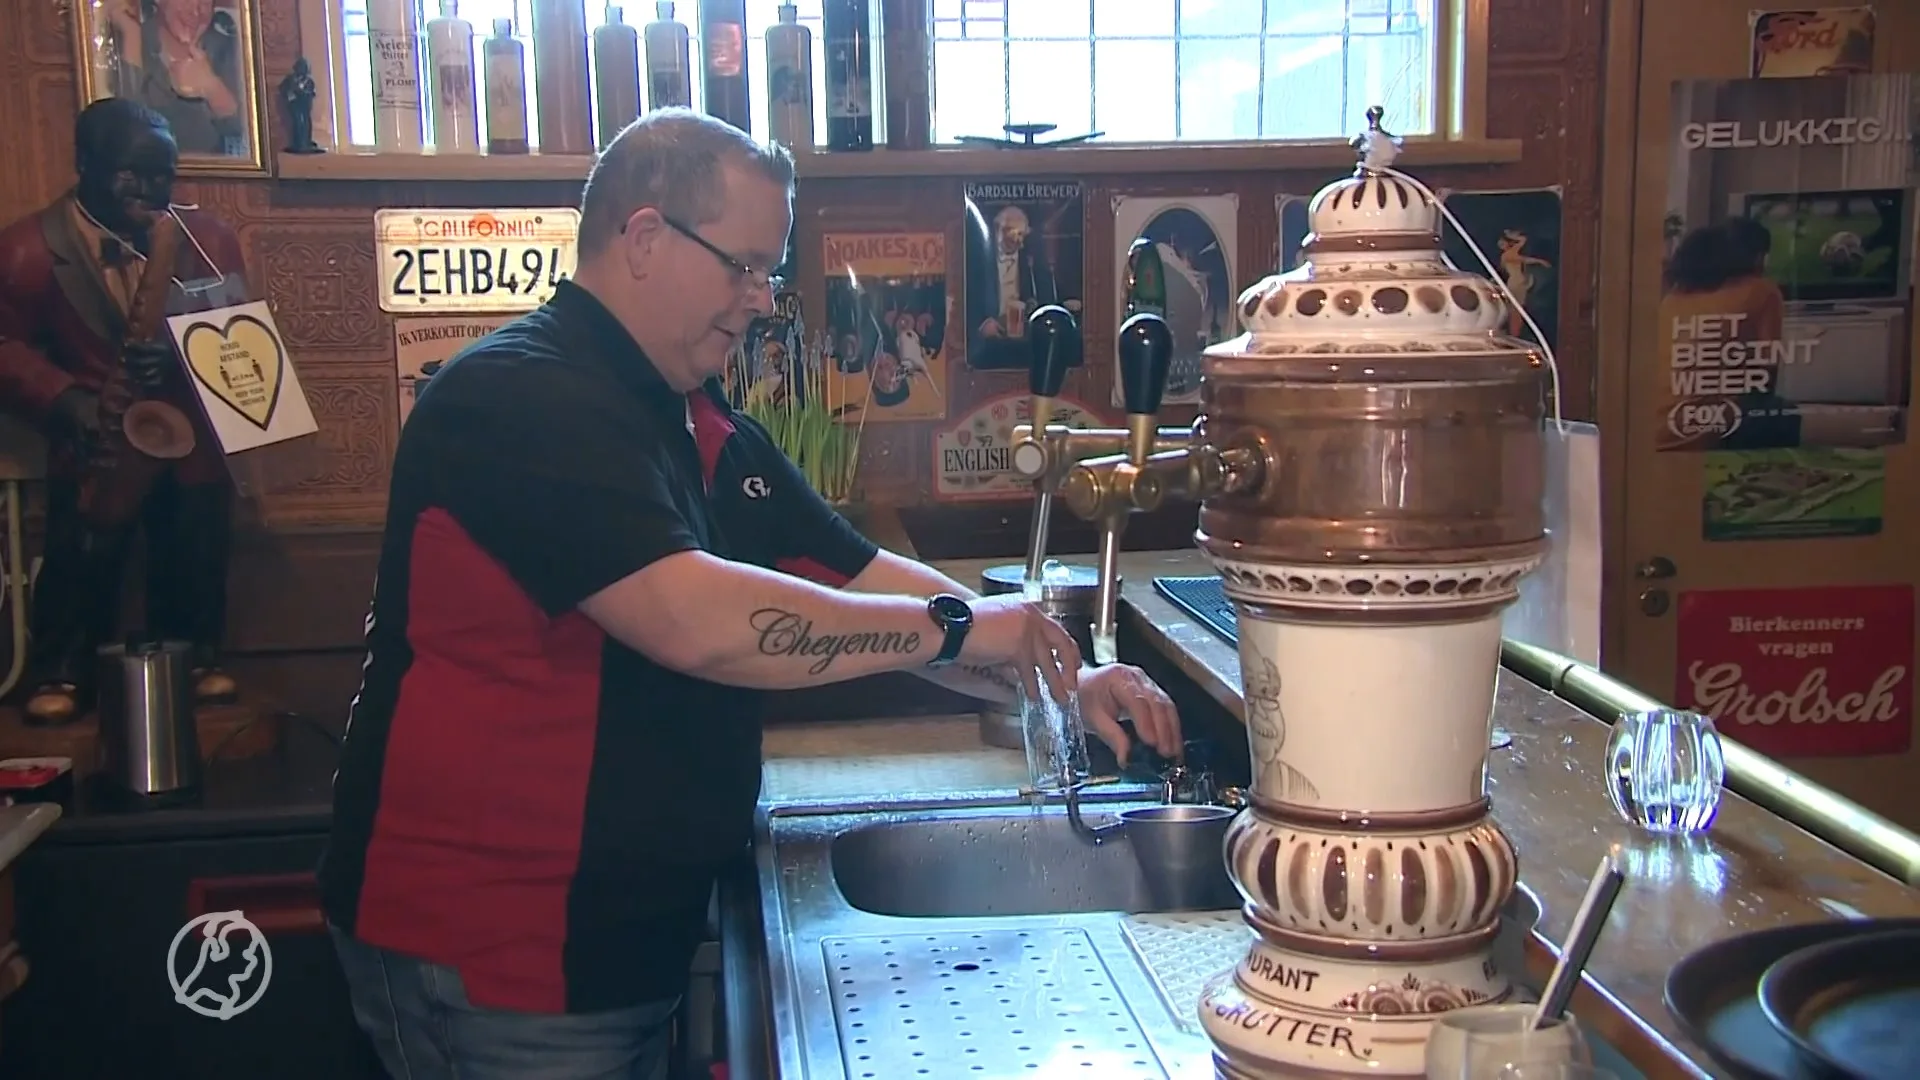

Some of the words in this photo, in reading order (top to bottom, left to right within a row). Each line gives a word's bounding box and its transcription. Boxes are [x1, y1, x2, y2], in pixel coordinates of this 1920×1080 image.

[967, 182, 1026, 198] BARDSLEY
[1027, 183, 1081, 198] BREWERY
[423, 218, 535, 237] CALIFORNIA
[398, 331, 412, 346] IK
[410, 324, 466, 342] VERKOCHT
[467, 325, 481, 338] OP
[1671, 313, 1748, 339] HET
[1671, 340, 1820, 368] BEGINT
[1671, 369, 1770, 396] WEER
[1682, 404, 1728, 425] FOX
[944, 447, 1010, 472] ENGLISH
[1728, 616, 1865, 633] Bierkenners
[749, 608, 921, 676] Cheyenne
[1758, 641, 1834, 659] vragen
[1688, 660, 1906, 726] Grolsch
